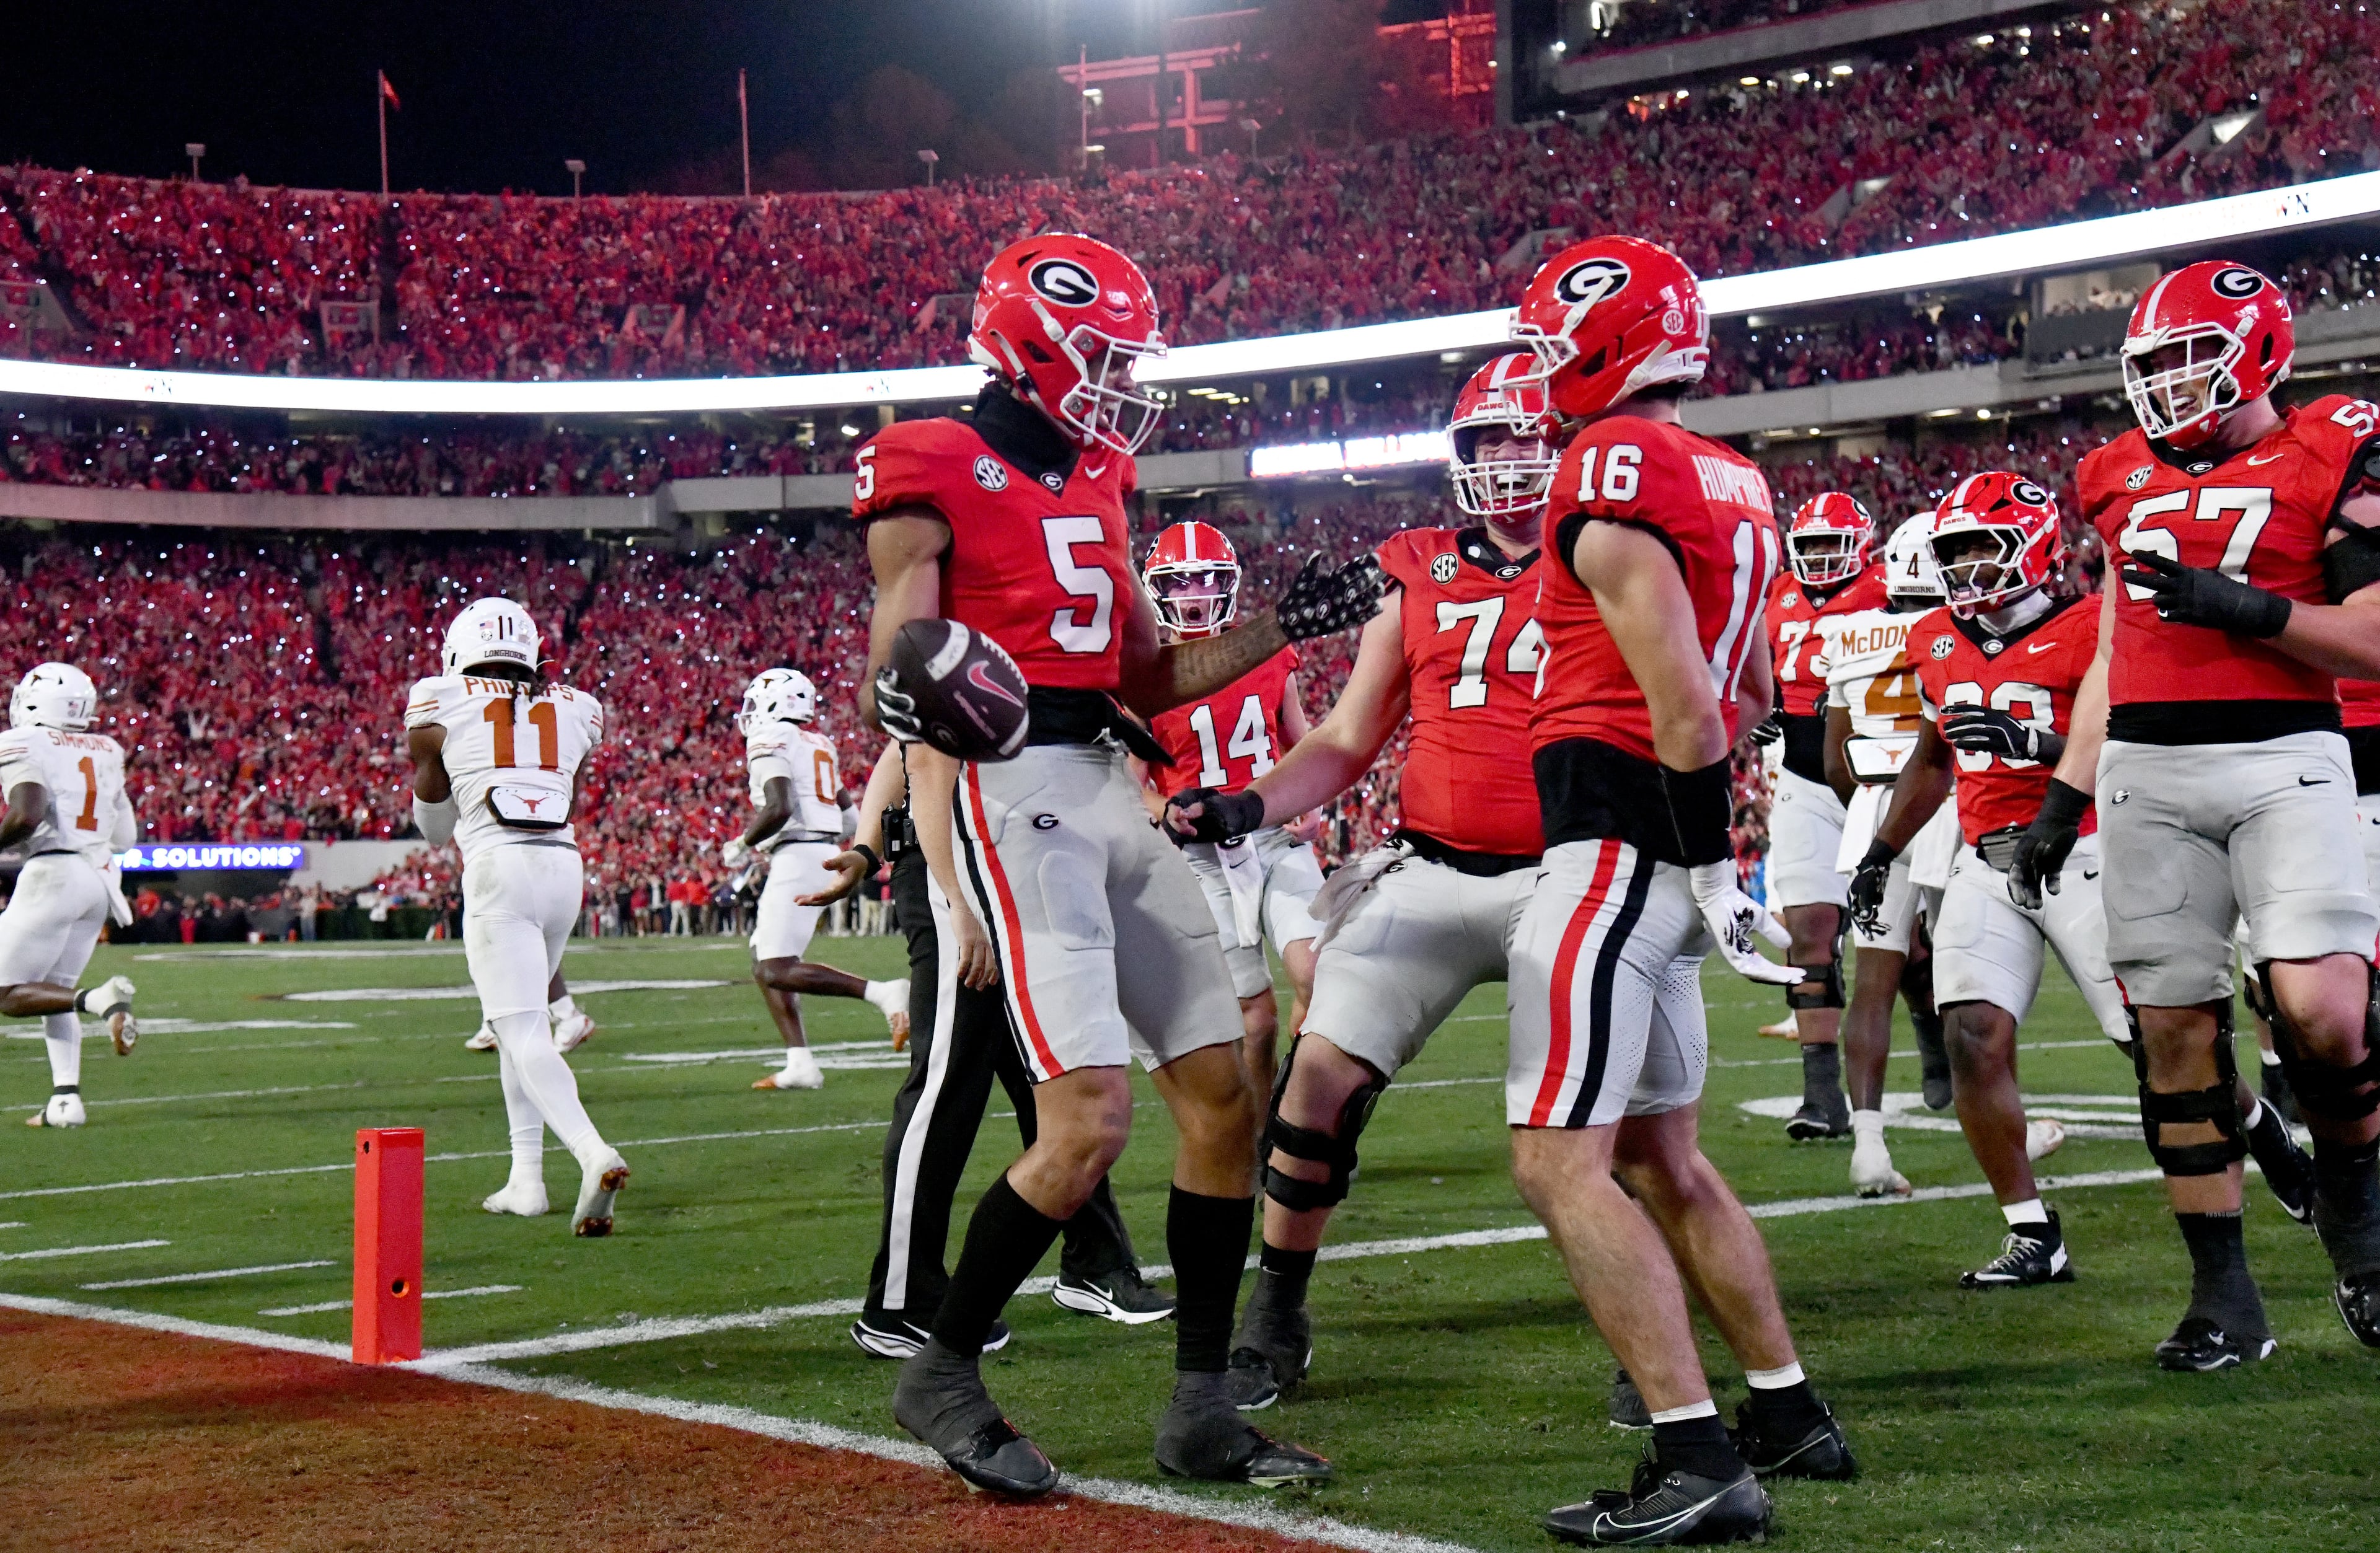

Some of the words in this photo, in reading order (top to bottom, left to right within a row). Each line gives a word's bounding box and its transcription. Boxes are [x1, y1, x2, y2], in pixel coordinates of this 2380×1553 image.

[1031, 260, 1097, 304] G
[2213, 268, 2263, 298] G
[1663, 310, 1683, 334] SEC
[854, 445, 876, 500] 5
[975, 455, 1008, 490] SEC
[1577, 444, 1643, 502] 16
[2188, 463, 2212, 472] G
[1041, 473, 1063, 490] G
[2012, 482, 2047, 506] G
[1944, 517, 1966, 525] DAWGS
[2119, 488, 2272, 601] 57
[1430, 553, 1458, 584] SEC
[1497, 566, 1522, 578] G
[1906, 553, 1919, 578] 4
[1041, 516, 1114, 653] 5
[498, 615, 513, 640] 11
[485, 649, 527, 662] LONGHORNS
[1931, 636, 1954, 659] SEC
[1985, 640, 2003, 653] G
[464, 677, 574, 702] PHILLPS
[1865, 651, 1923, 731] 4
[484, 698, 558, 771] 11
[1189, 695, 1275, 788] 14
[814, 750, 836, 806] 0
[76, 756, 98, 831] 1
[1032, 814, 1059, 830] G
